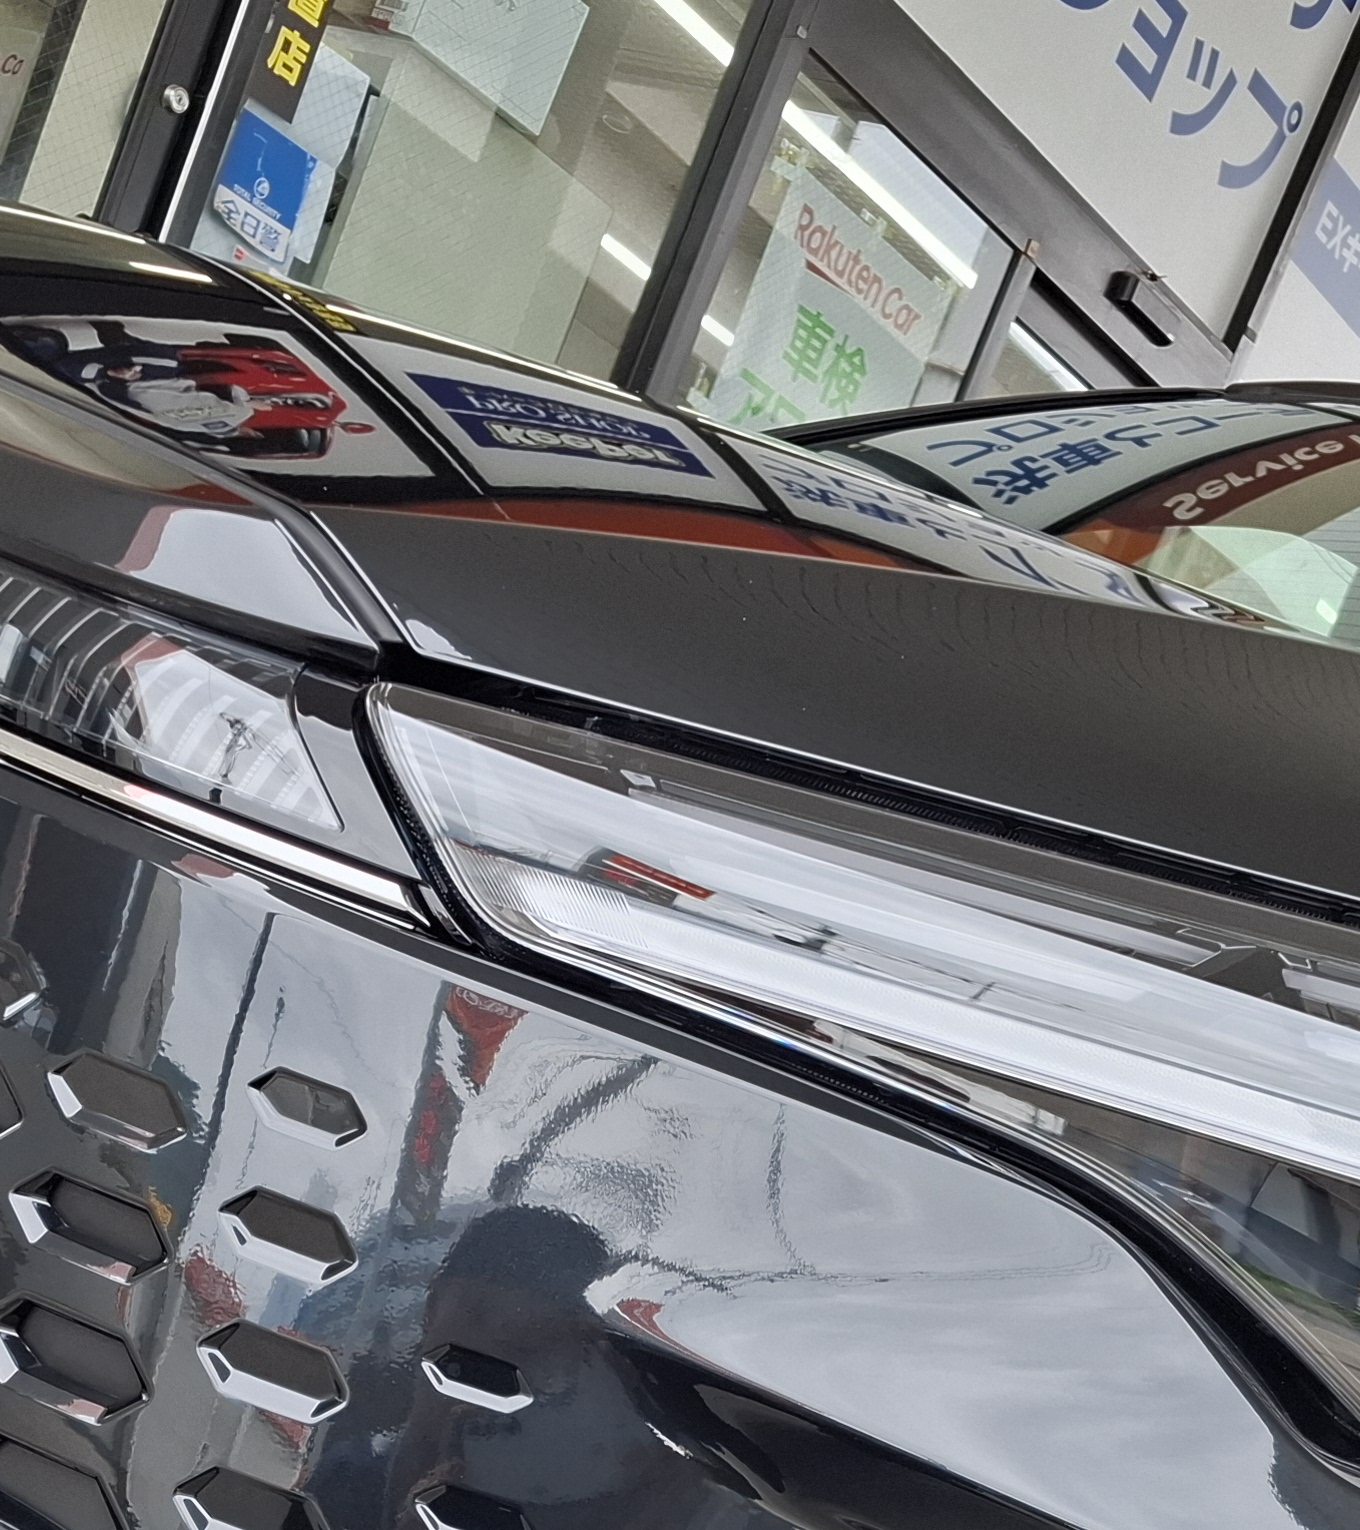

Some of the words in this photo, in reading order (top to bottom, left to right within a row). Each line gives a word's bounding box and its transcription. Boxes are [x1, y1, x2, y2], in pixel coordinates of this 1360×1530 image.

[793, 203, 883, 309] Rakuten
[881, 287, 923, 336] Car
[782, 303, 869, 416] 車検
